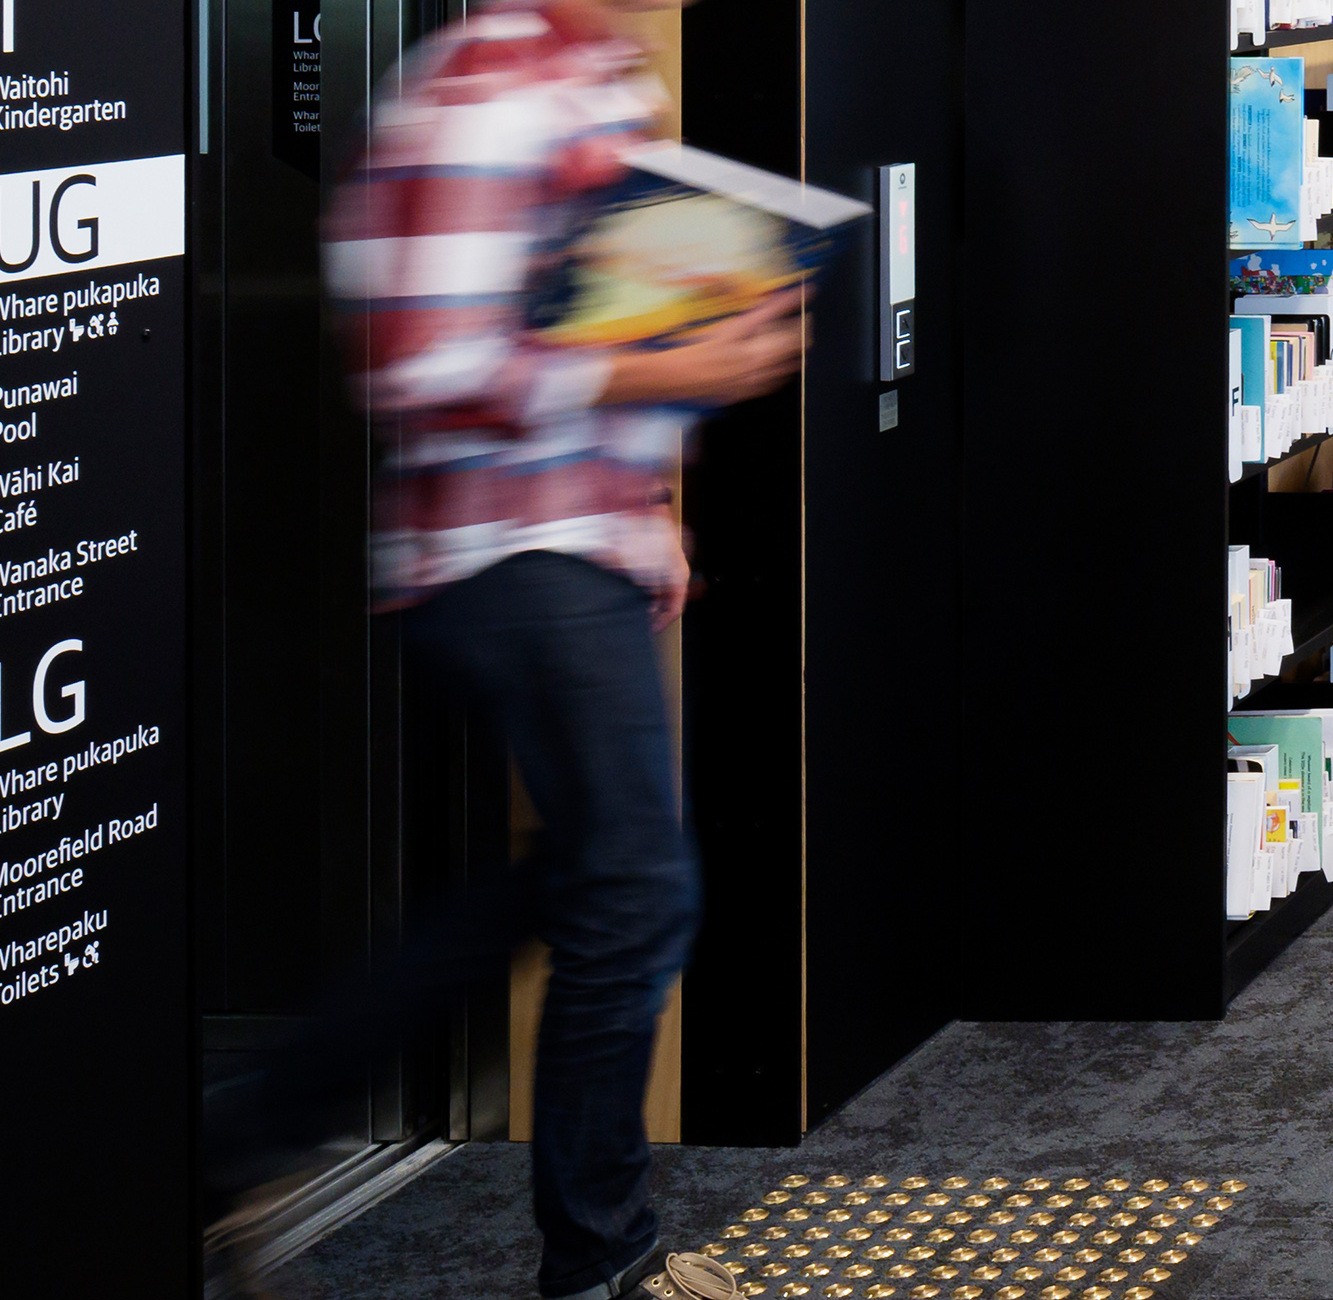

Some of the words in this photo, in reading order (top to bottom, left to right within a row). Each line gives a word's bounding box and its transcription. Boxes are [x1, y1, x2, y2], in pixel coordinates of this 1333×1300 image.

[63, 273, 160, 317] pukapuka
[48, 457, 80, 487] Kai
[76, 529, 138, 566] Street
[63, 723, 160, 782] pukapuka
[108, 803, 159, 845] Road
